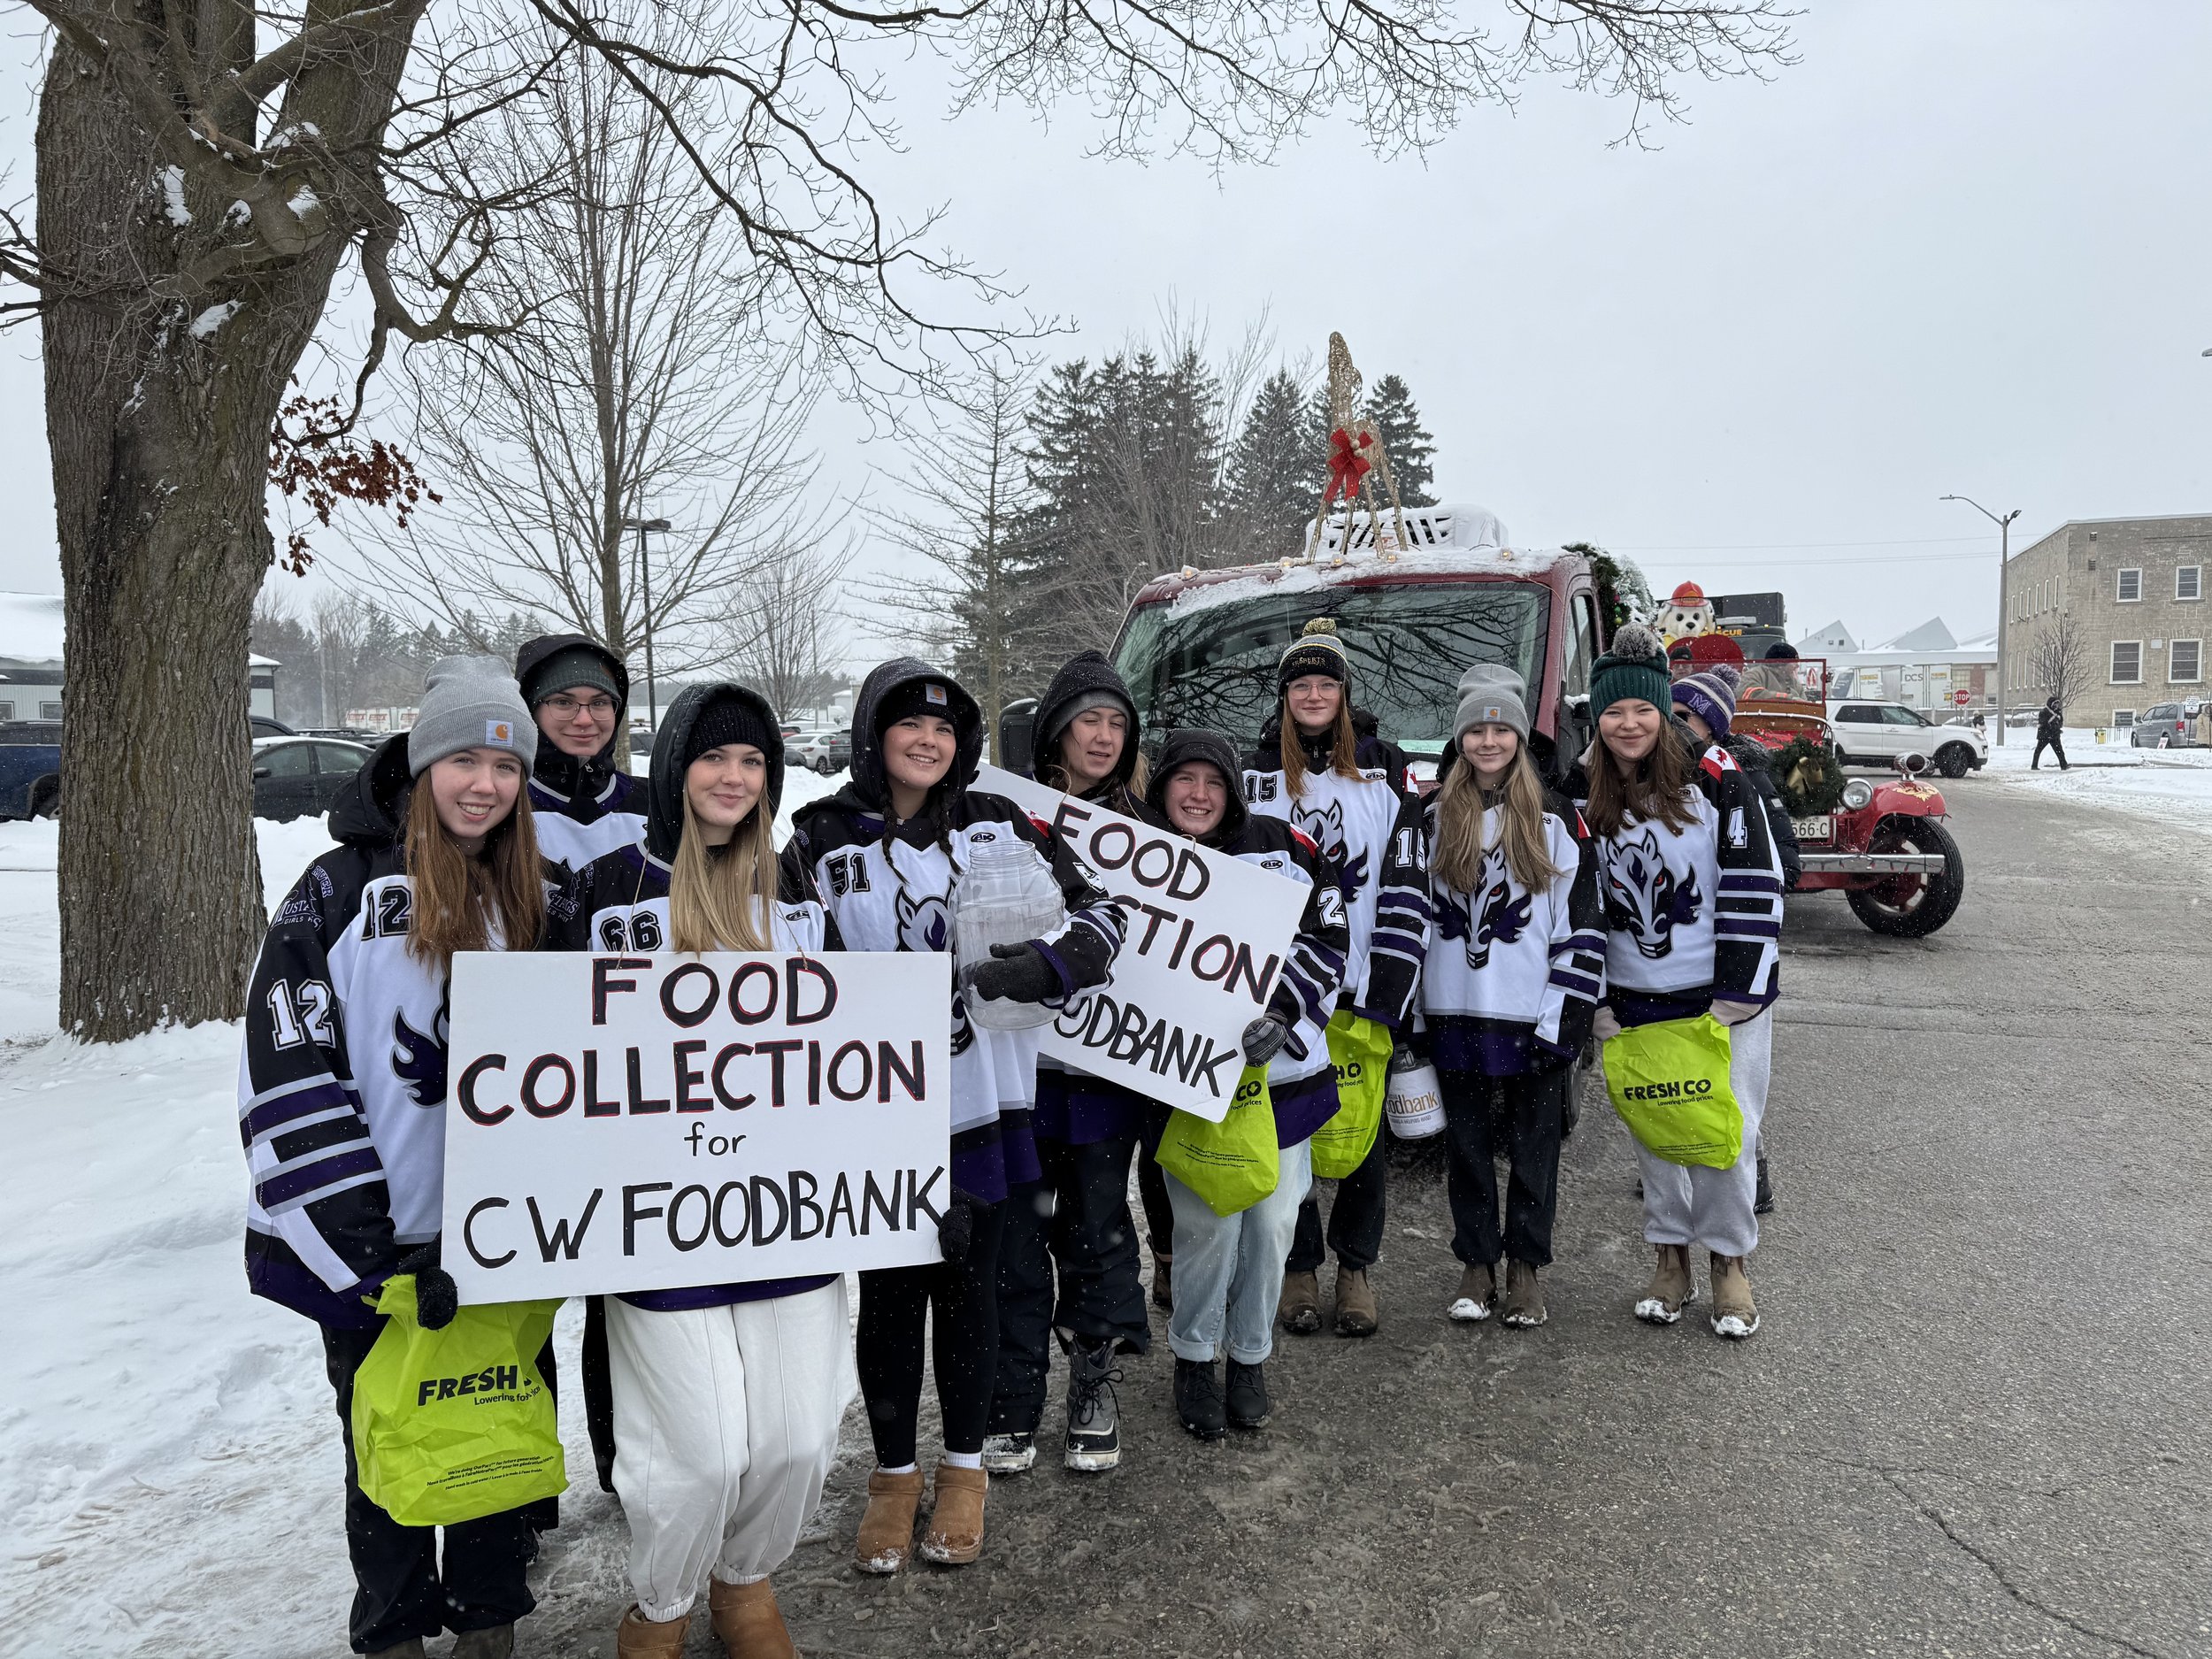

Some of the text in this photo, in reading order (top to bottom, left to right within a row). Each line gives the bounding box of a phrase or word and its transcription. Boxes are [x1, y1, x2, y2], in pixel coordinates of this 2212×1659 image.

[1687, 692, 1711, 715] M
[1245, 773, 1278, 803] 15
[1727, 806, 1747, 849] 4
[1056, 802, 1210, 902] FOOD
[1317, 886, 1347, 928] 2
[591, 957, 839, 1028] FOOD
[267, 979, 336, 1051] 12
[457, 1039, 926, 1126] COLLECTION
[684, 1121, 746, 1156] for
[622, 1165, 945, 1256] FOODBANK
[418, 1365, 518, 1406] FRESH
[474, 1393, 515, 1405] Lowering
